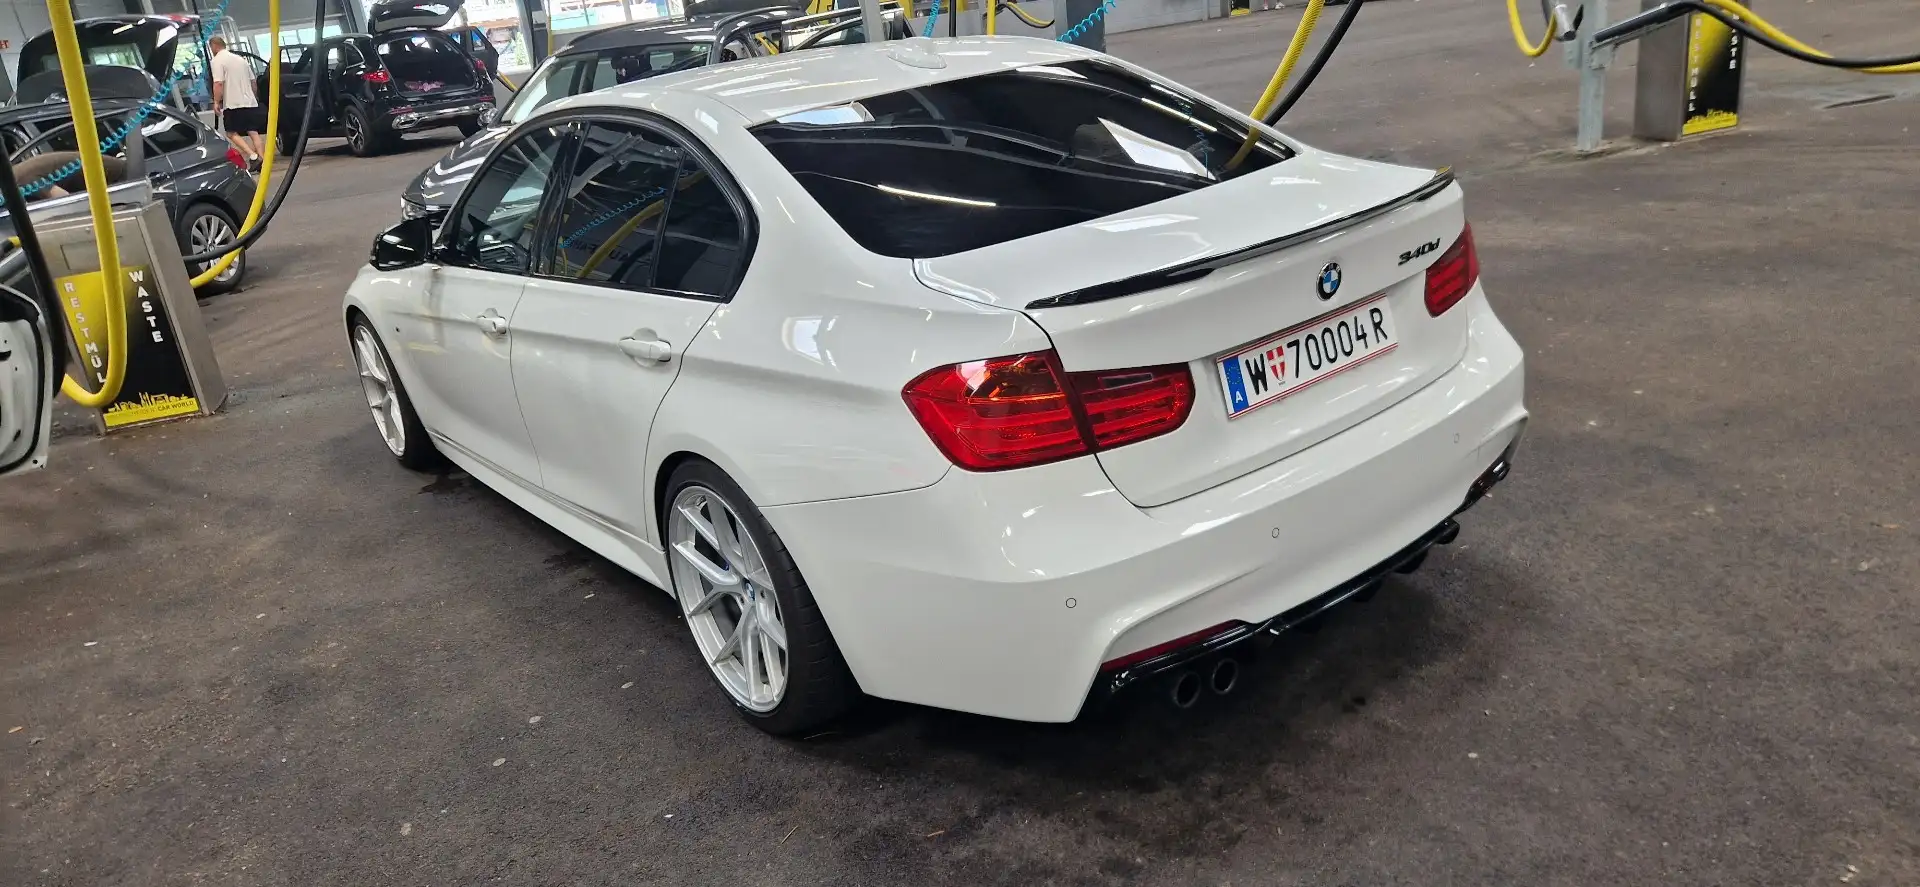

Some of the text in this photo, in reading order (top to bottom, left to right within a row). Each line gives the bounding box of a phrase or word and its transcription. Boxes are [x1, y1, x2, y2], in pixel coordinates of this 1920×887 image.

[1398, 237, 1441, 266] 340d
[128, 270, 163, 343] WASTE
[64, 282, 107, 384] RESTMÜL
[1245, 307, 1388, 395] W 70004 R
[157, 403, 171, 412] CAR
[171, 400, 194, 409] WORLD
[1235, 390, 1244, 403] A
